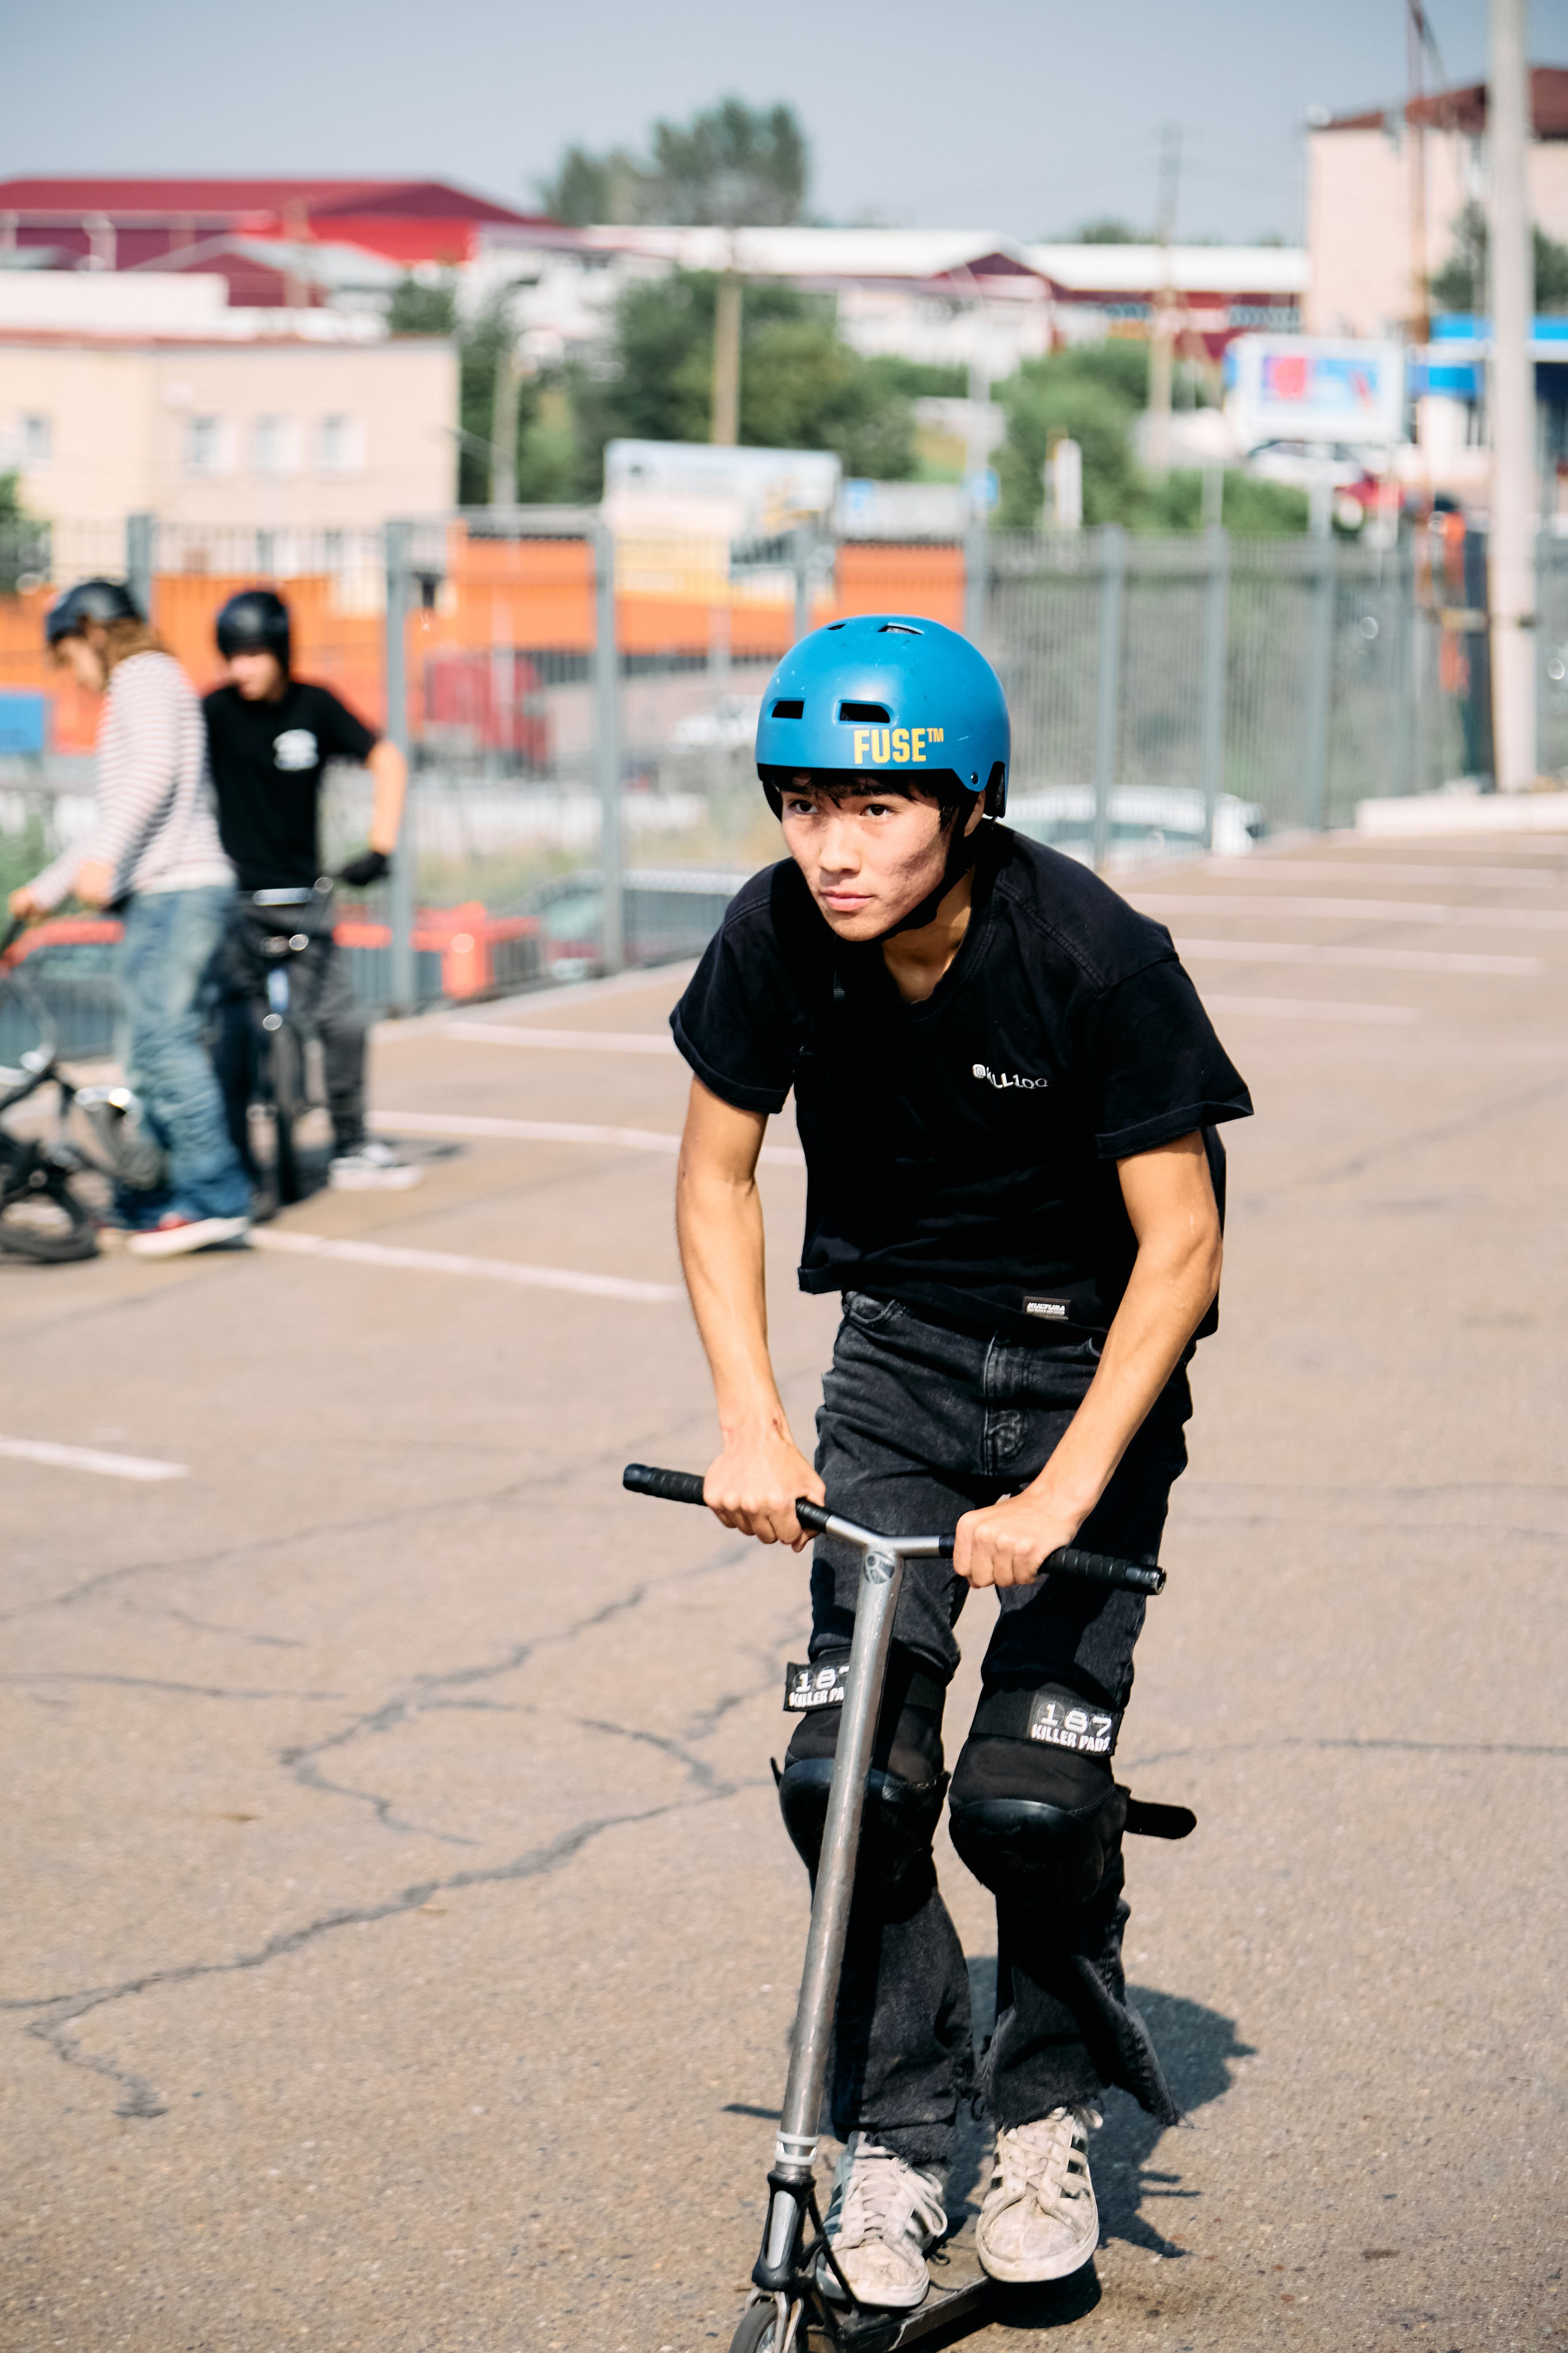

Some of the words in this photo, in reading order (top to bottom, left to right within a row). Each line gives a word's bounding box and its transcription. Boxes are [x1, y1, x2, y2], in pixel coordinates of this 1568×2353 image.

[789, 1690, 829, 1708] KILLER
[828, 1686, 845, 1702] PA
[1041, 1703, 1112, 1737] 187
[1030, 1723, 1077, 1748] KILLER
